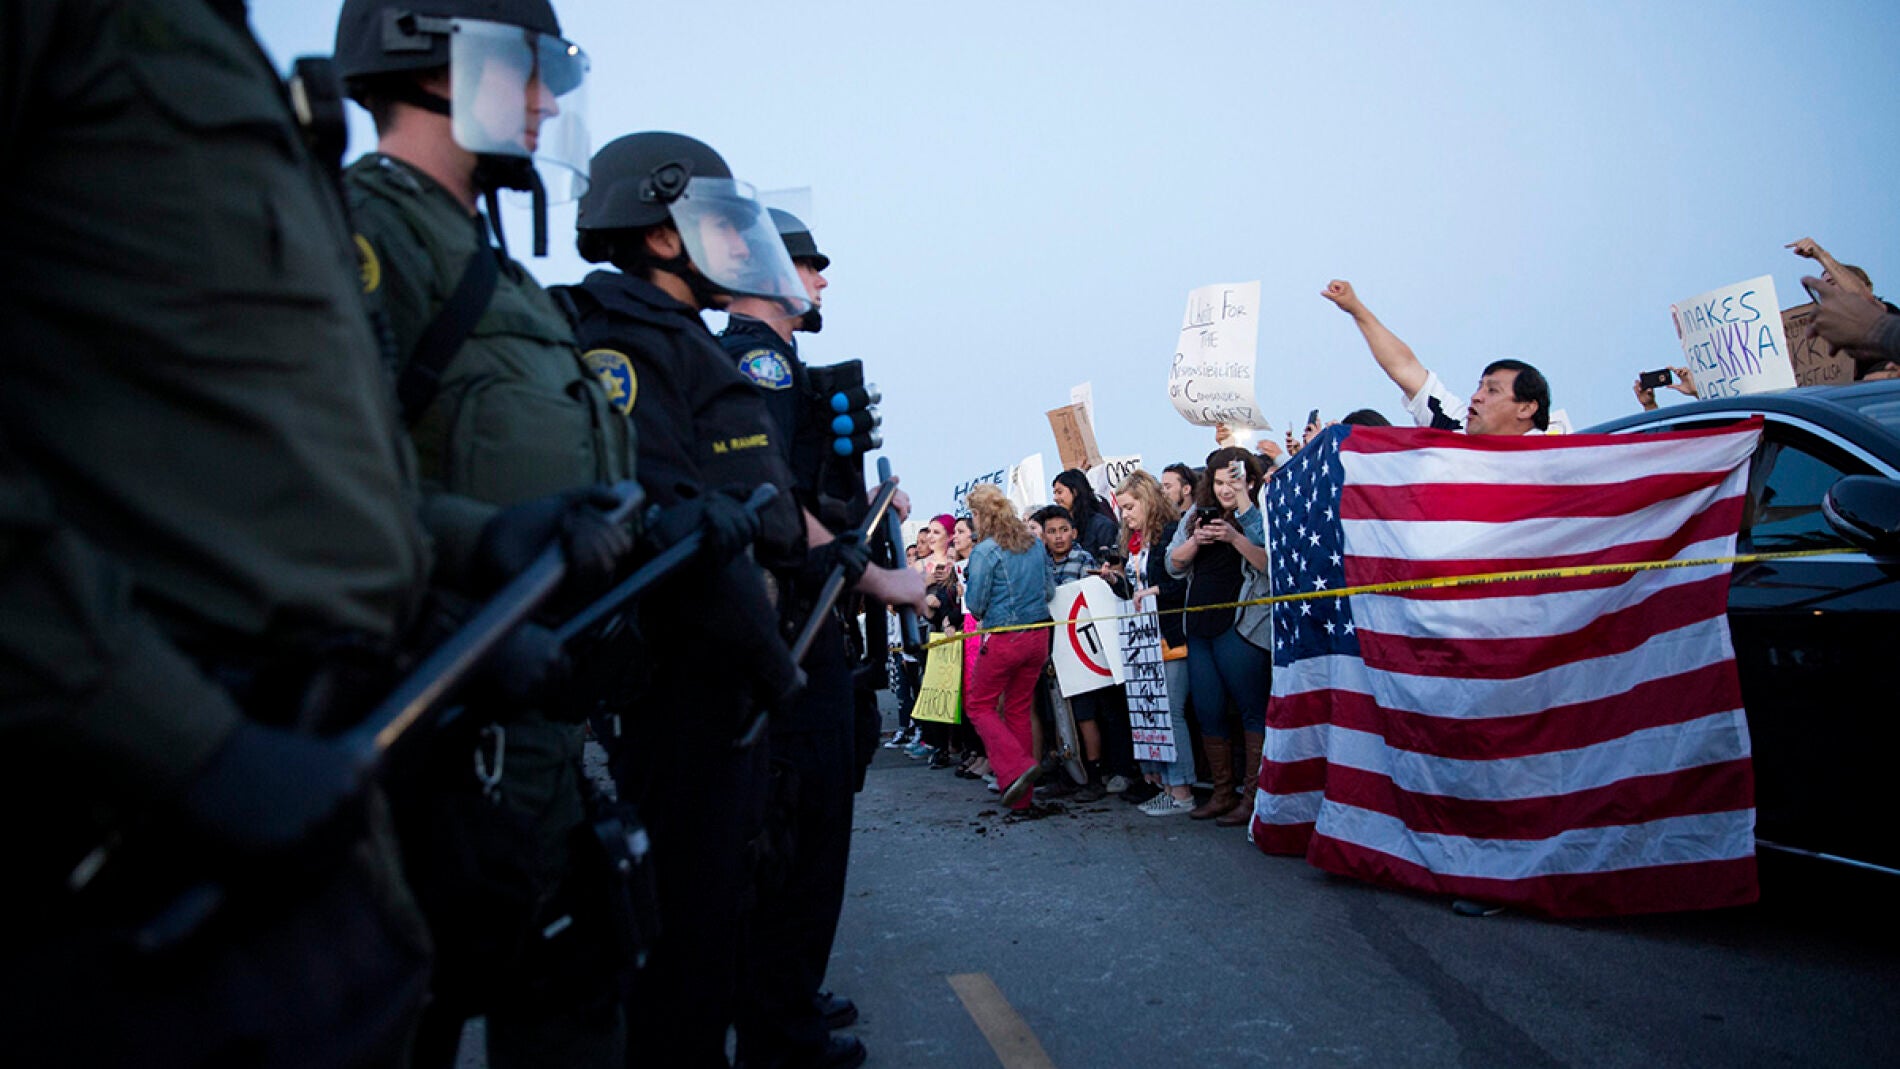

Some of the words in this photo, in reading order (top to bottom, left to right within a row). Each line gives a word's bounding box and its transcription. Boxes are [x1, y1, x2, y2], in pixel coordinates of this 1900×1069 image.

[1682, 290, 1761, 335] MAKES
[1200, 330, 1218, 348] THE
[954, 469, 1004, 501] HATE
